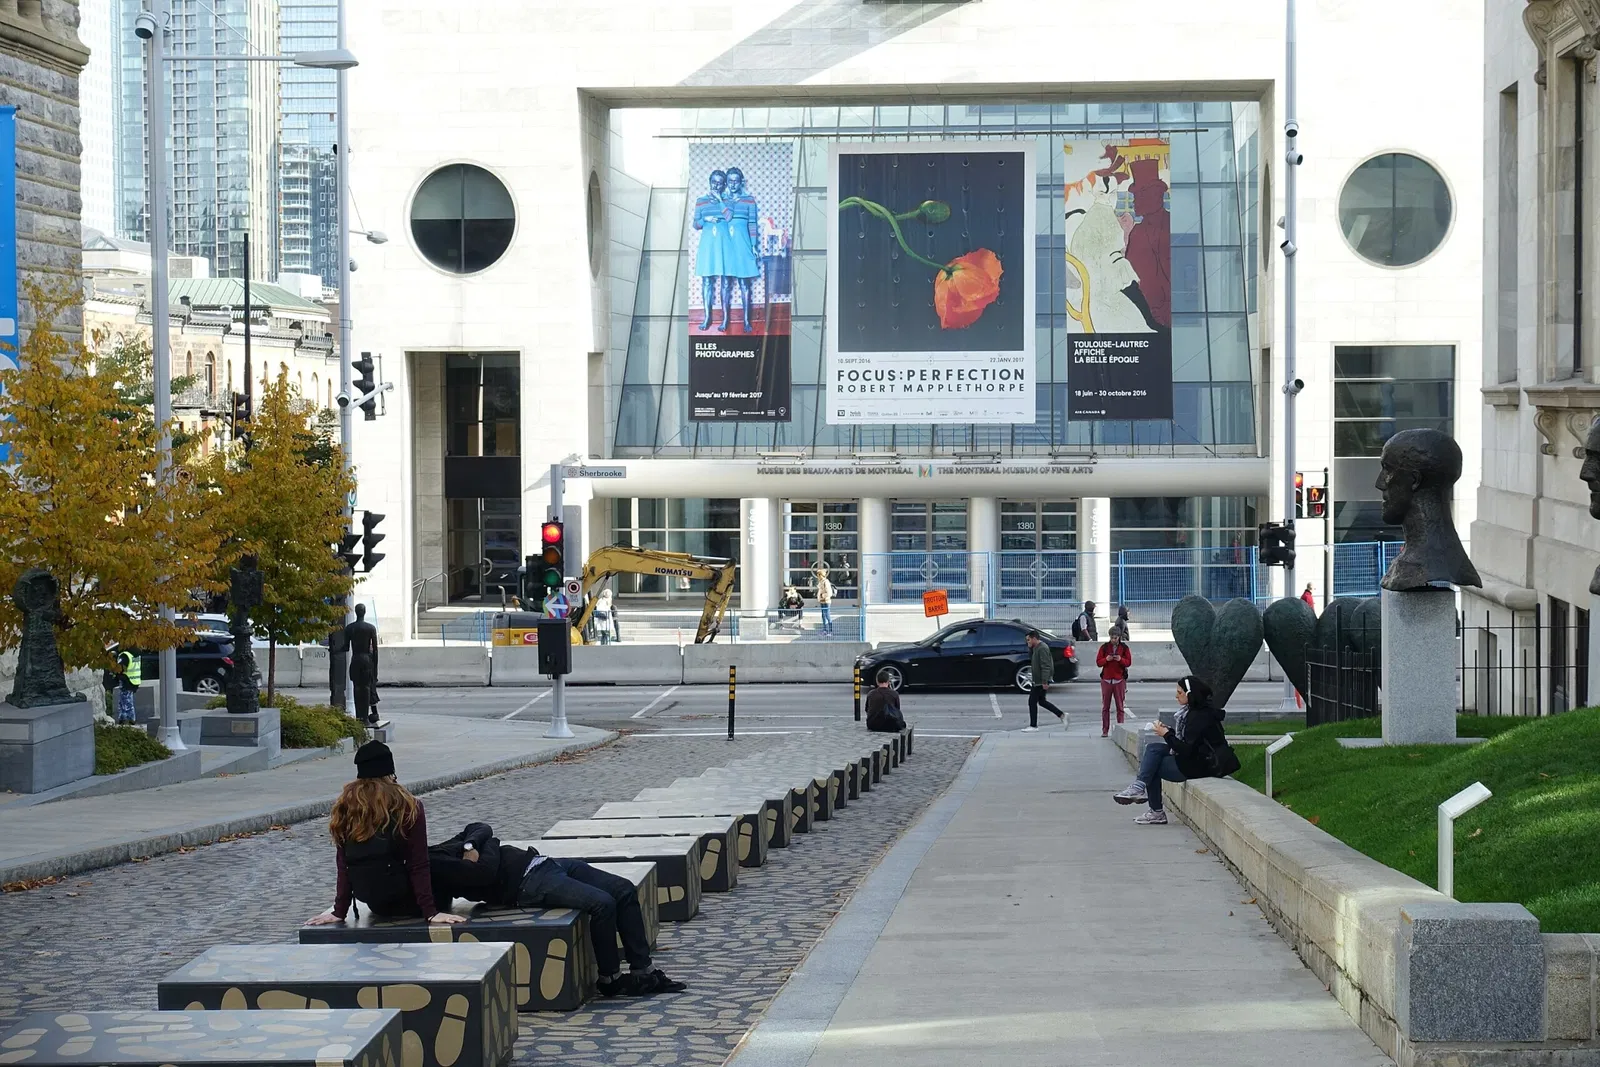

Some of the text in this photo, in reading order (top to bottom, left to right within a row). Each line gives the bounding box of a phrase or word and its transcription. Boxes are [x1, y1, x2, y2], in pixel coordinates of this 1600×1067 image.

[1074, 340, 1149, 348] TOULOUSE-LAUTREC
[695, 350, 755, 358] PHOTOGRAPHES
[1109, 354, 1139, 363] ÉPOQUE
[837, 369, 1024, 381] FOCUS:PERFECTION
[837, 383, 1024, 393] ROBERT MAPPLETHORPE
[695, 391, 721, 399] Jusqu'au
[1082, 390, 1093, 398] juin
[757, 466, 785, 475] MUSÉE
[785, 467, 801, 475] DES
[855, 467, 866, 475] DE
[868, 466, 913, 475] MONTRÉAL
[747, 509, 756, 546] Entrée
[825, 522, 843, 530] 1380
[1017, 522, 1035, 530] 1380
[1090, 508, 1098, 546] Entrée
[655, 567, 693, 576] KOMATSU
